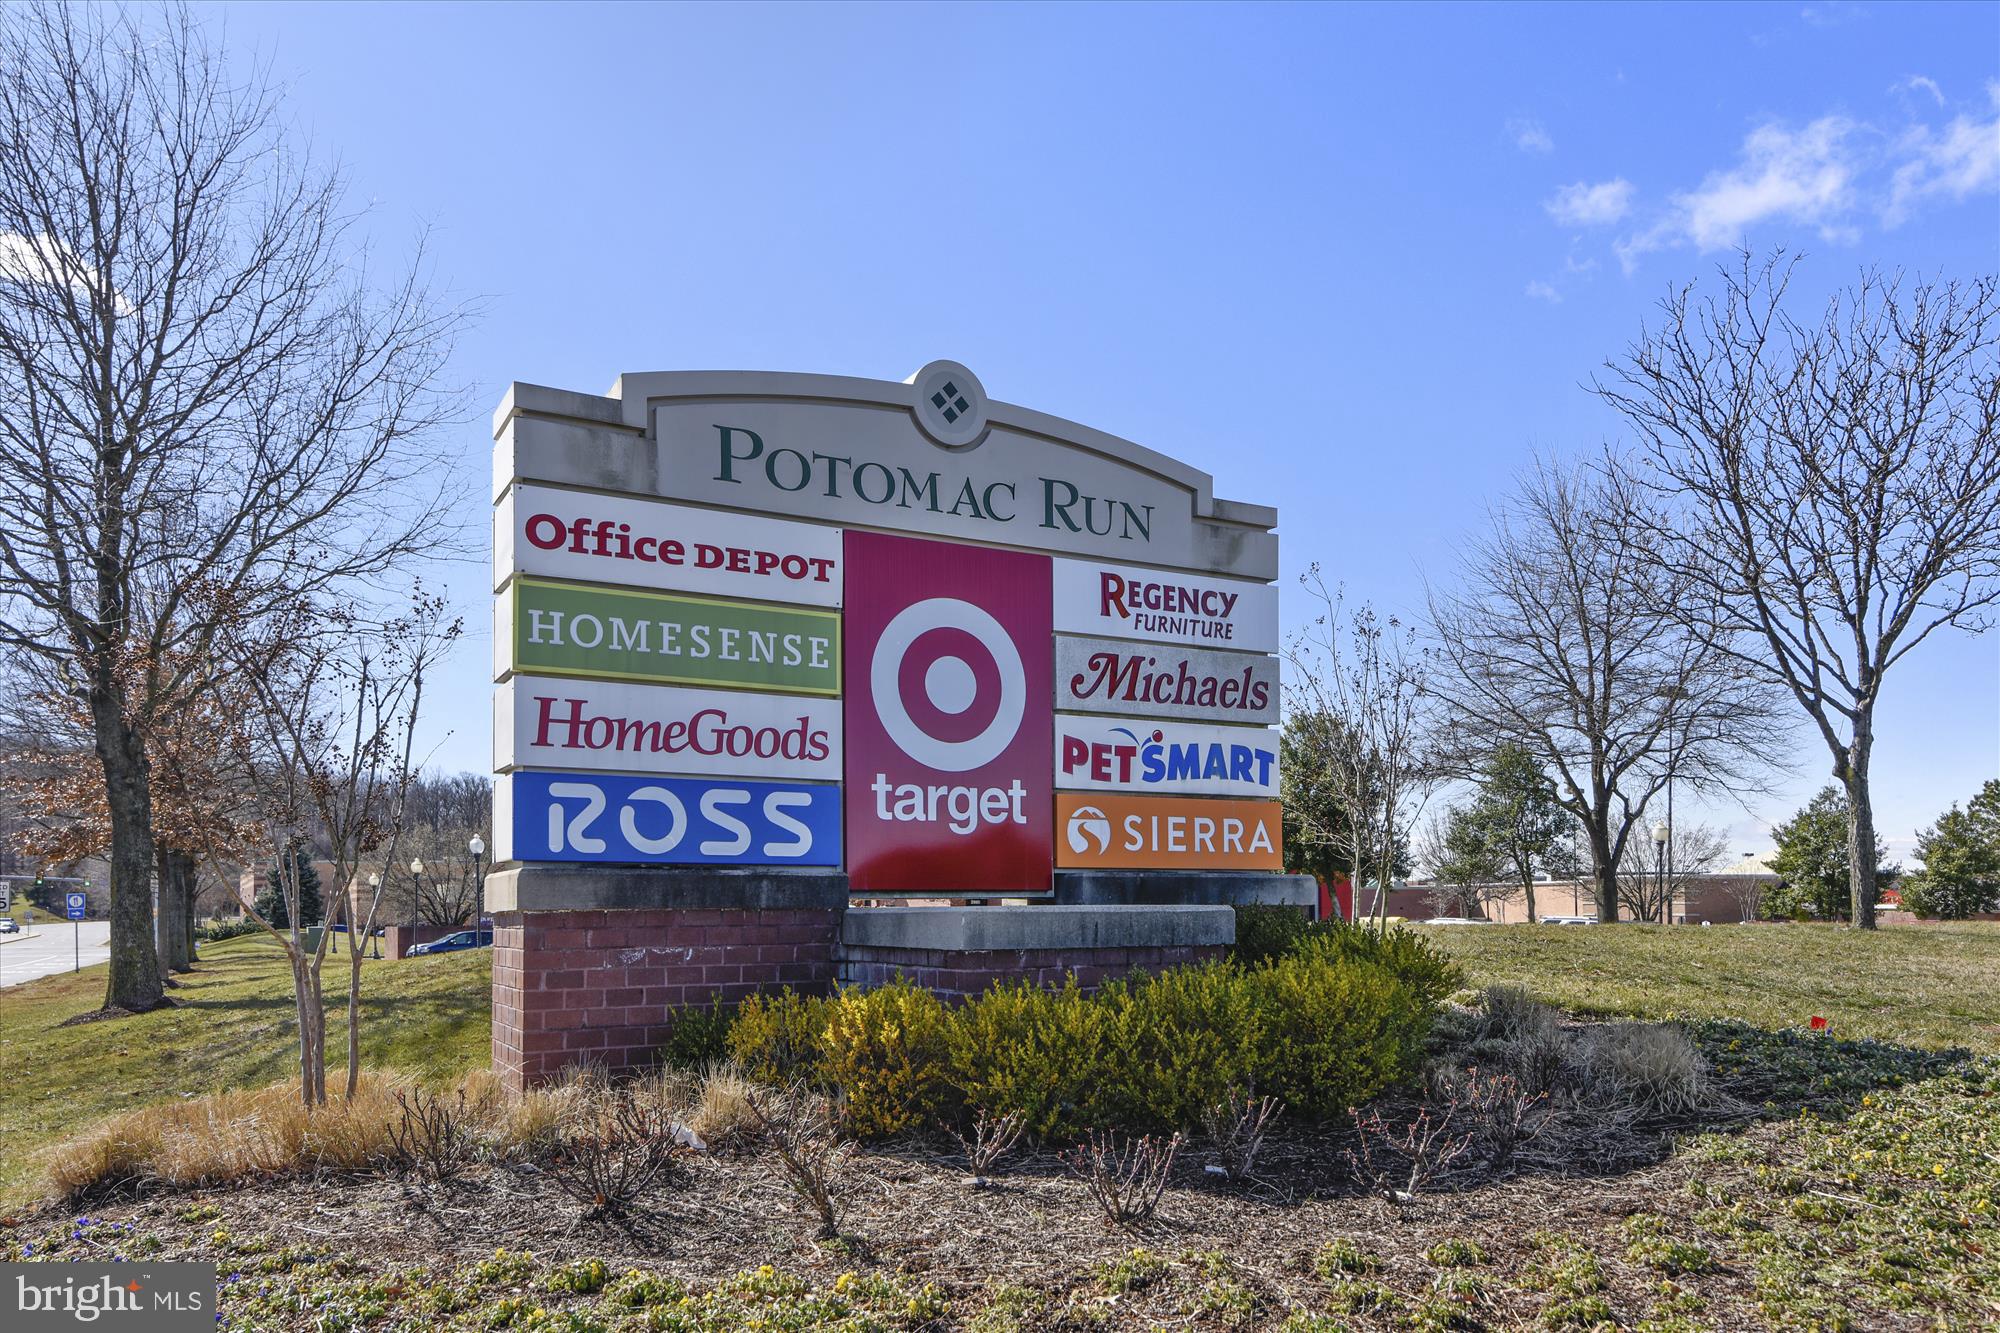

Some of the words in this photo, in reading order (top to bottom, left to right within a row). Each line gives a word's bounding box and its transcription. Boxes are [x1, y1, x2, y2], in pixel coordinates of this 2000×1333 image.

[712, 424, 1016, 522] POTOMAC
[1038, 477, 1155, 543] RUN
[525, 514, 685, 565] Office
[694, 544, 835, 582] DEPOT
[1100, 572, 1238, 619] REGENCY
[527, 609, 829, 668] HOMESENSE
[1134, 613, 1233, 640] FURNITURE
[1070, 653, 1269, 710] Michaels
[530, 696, 830, 761] HomeGoods
[1062, 734, 1275, 787] PETSMART
[549, 782, 813, 857] ROSS
[871, 773, 1027, 835] target
[1123, 815, 1274, 854] SIERRA
